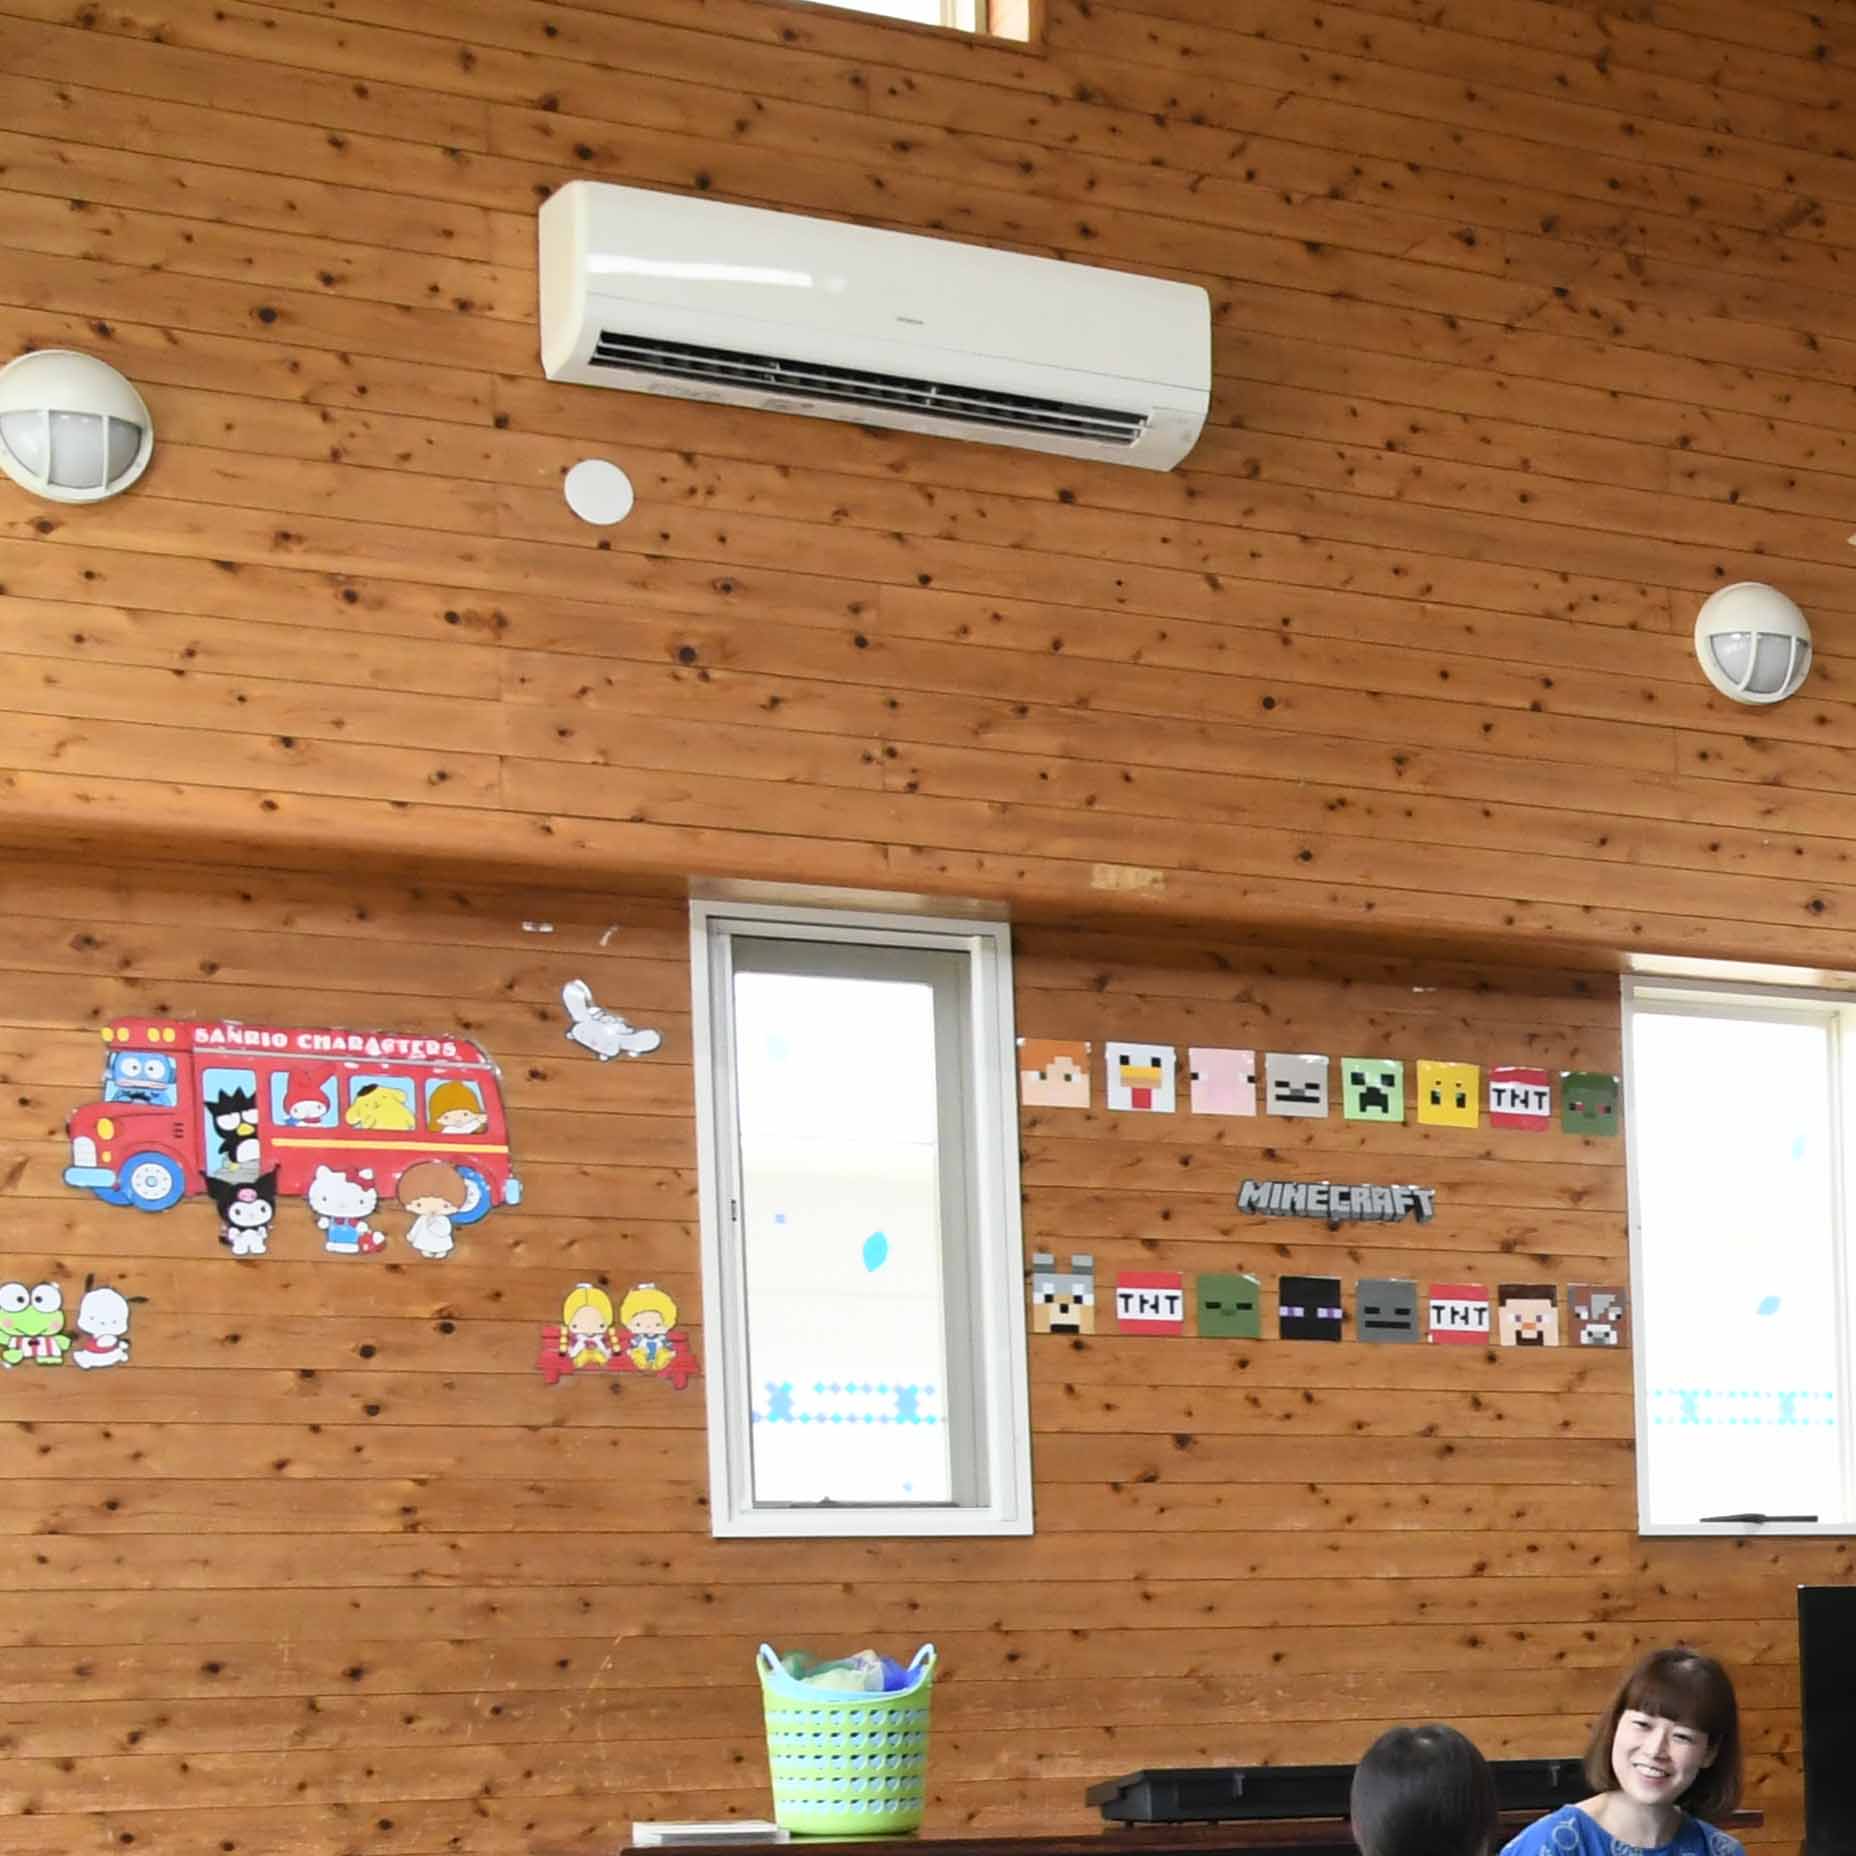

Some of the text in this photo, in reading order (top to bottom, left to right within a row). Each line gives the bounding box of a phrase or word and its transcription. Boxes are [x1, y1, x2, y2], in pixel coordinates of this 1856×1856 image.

[194, 1026, 457, 1058] SANRIO CHARACTERS
[1492, 1088, 1547, 1110] TNT
[1237, 1179, 1435, 1223] MINECRAFT
[1118, 1293, 1180, 1315] TNT
[1431, 1305, 1488, 1326] TNT
